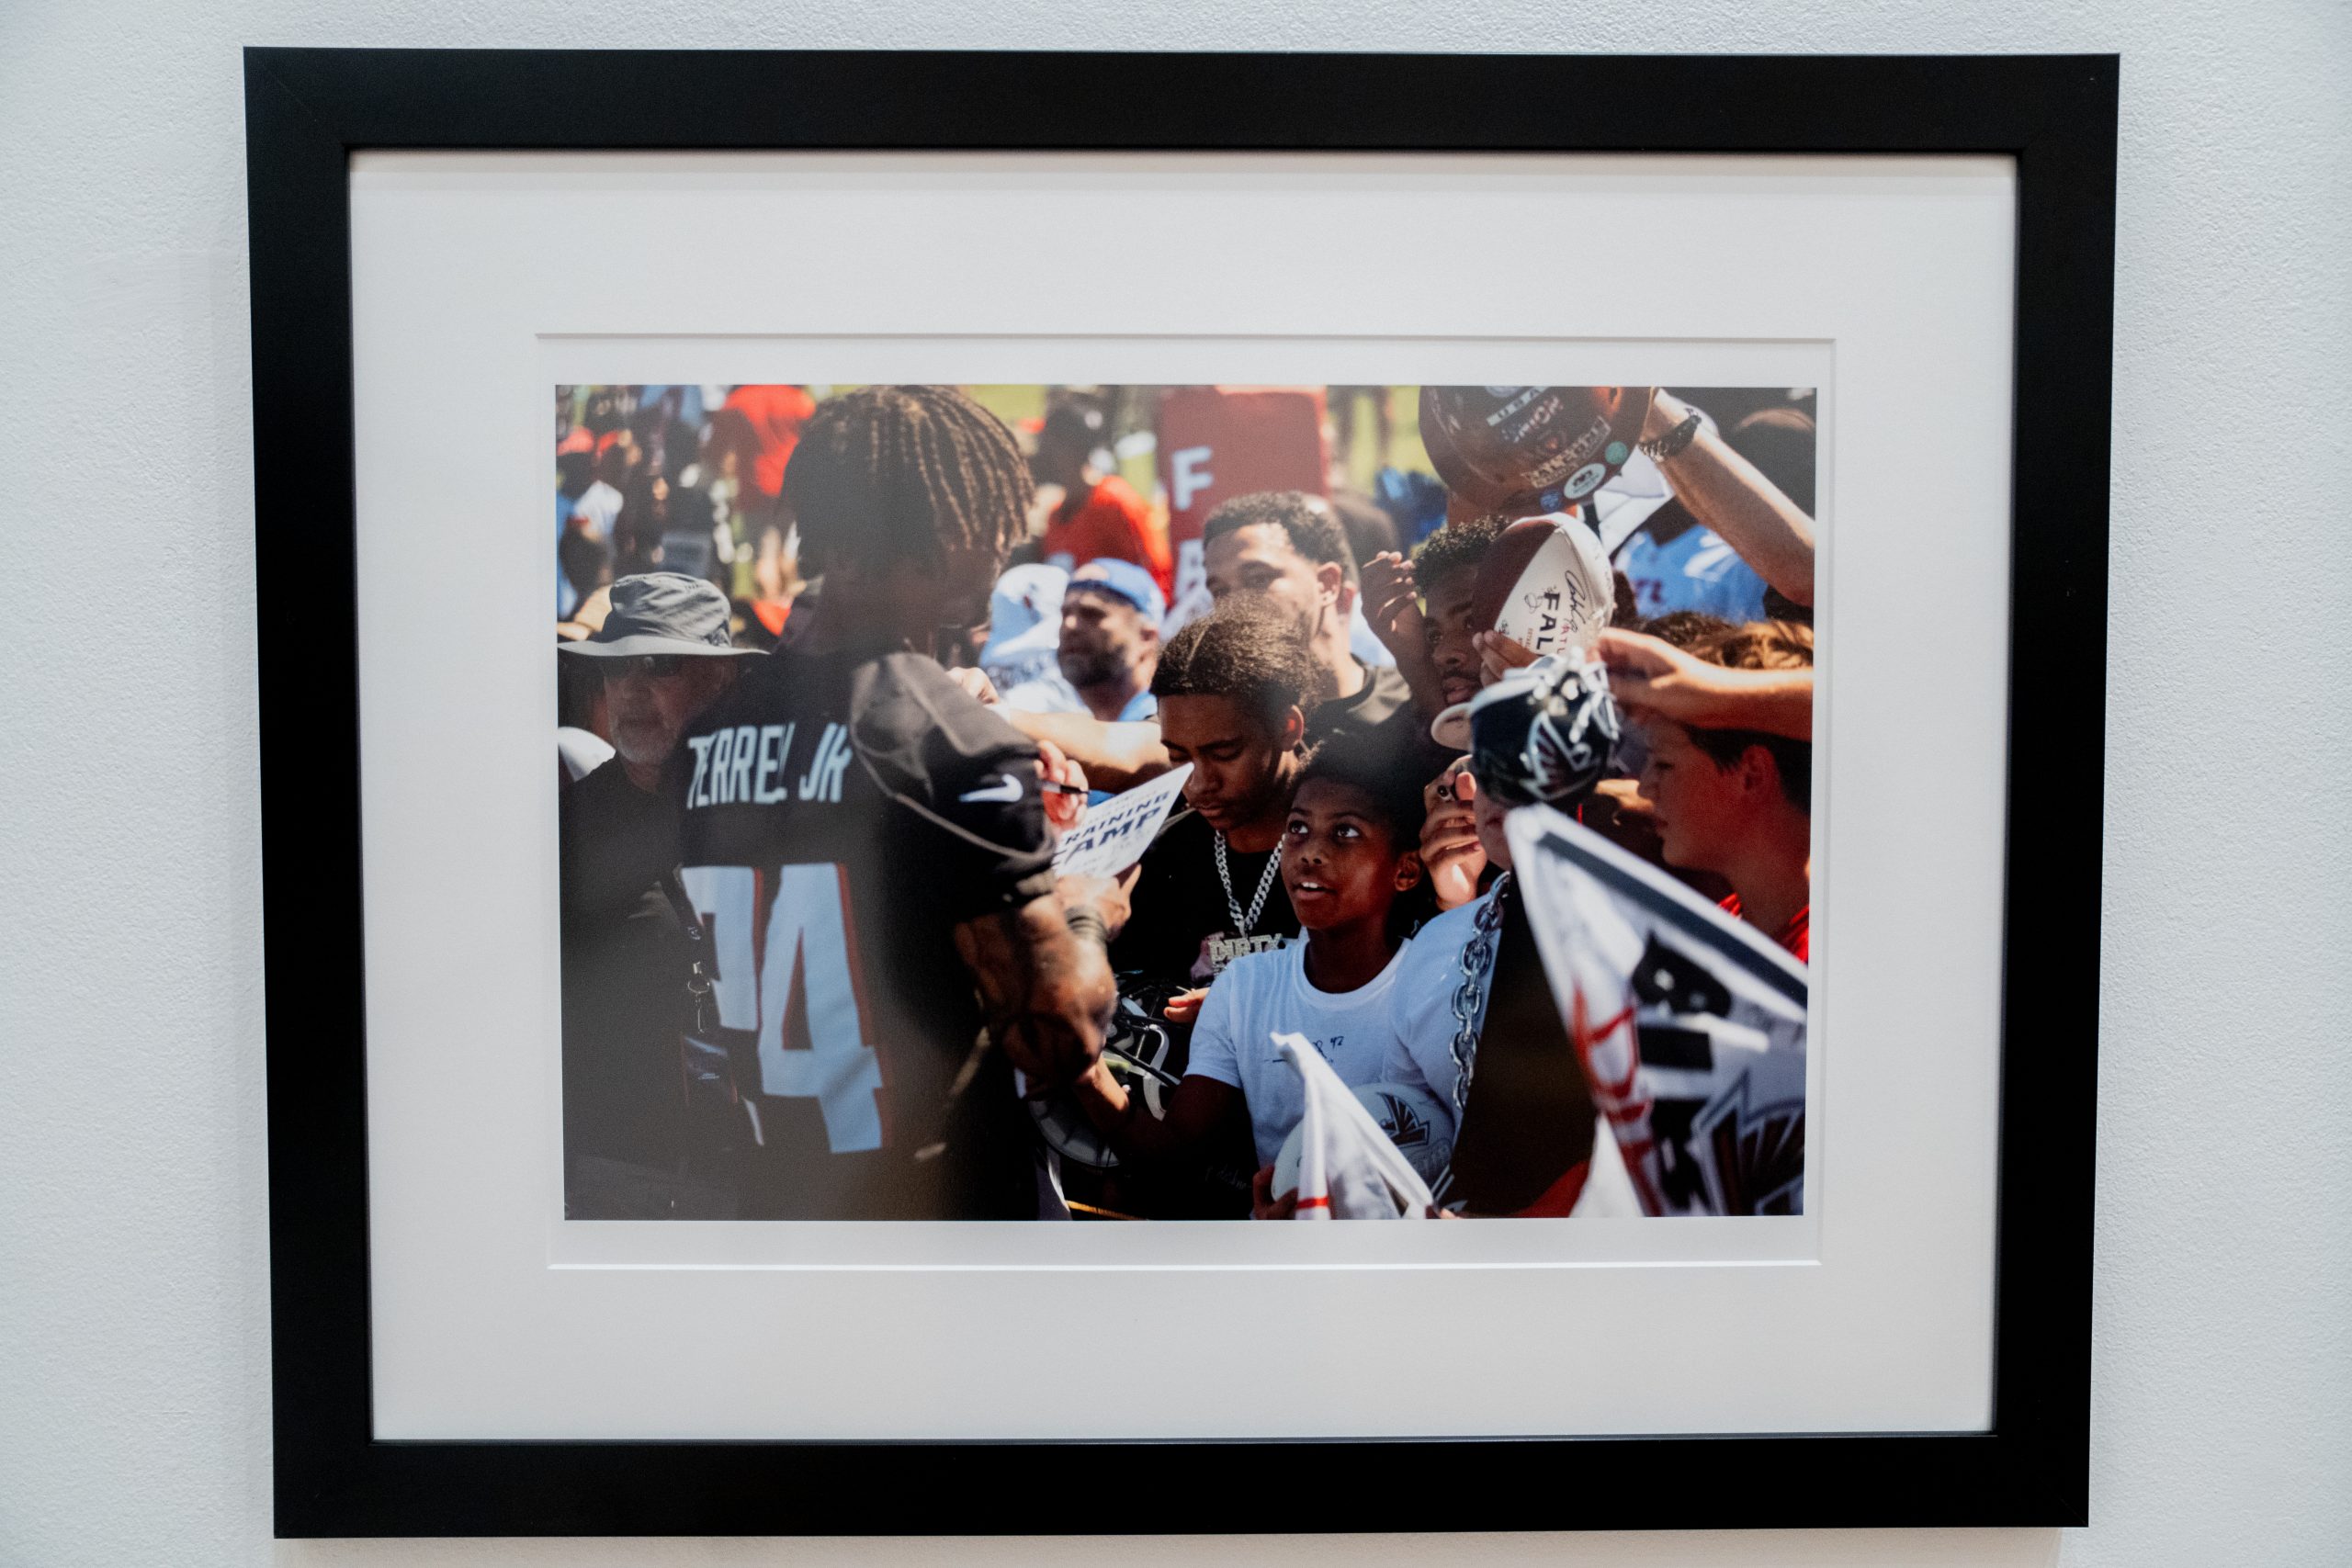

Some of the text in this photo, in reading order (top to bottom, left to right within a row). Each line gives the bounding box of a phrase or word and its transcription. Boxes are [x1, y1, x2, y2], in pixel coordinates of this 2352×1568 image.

[1536, 591, 1561, 656] FAL
[798, 722, 853, 804] JR
[1065, 790, 1170, 845] RAINING
